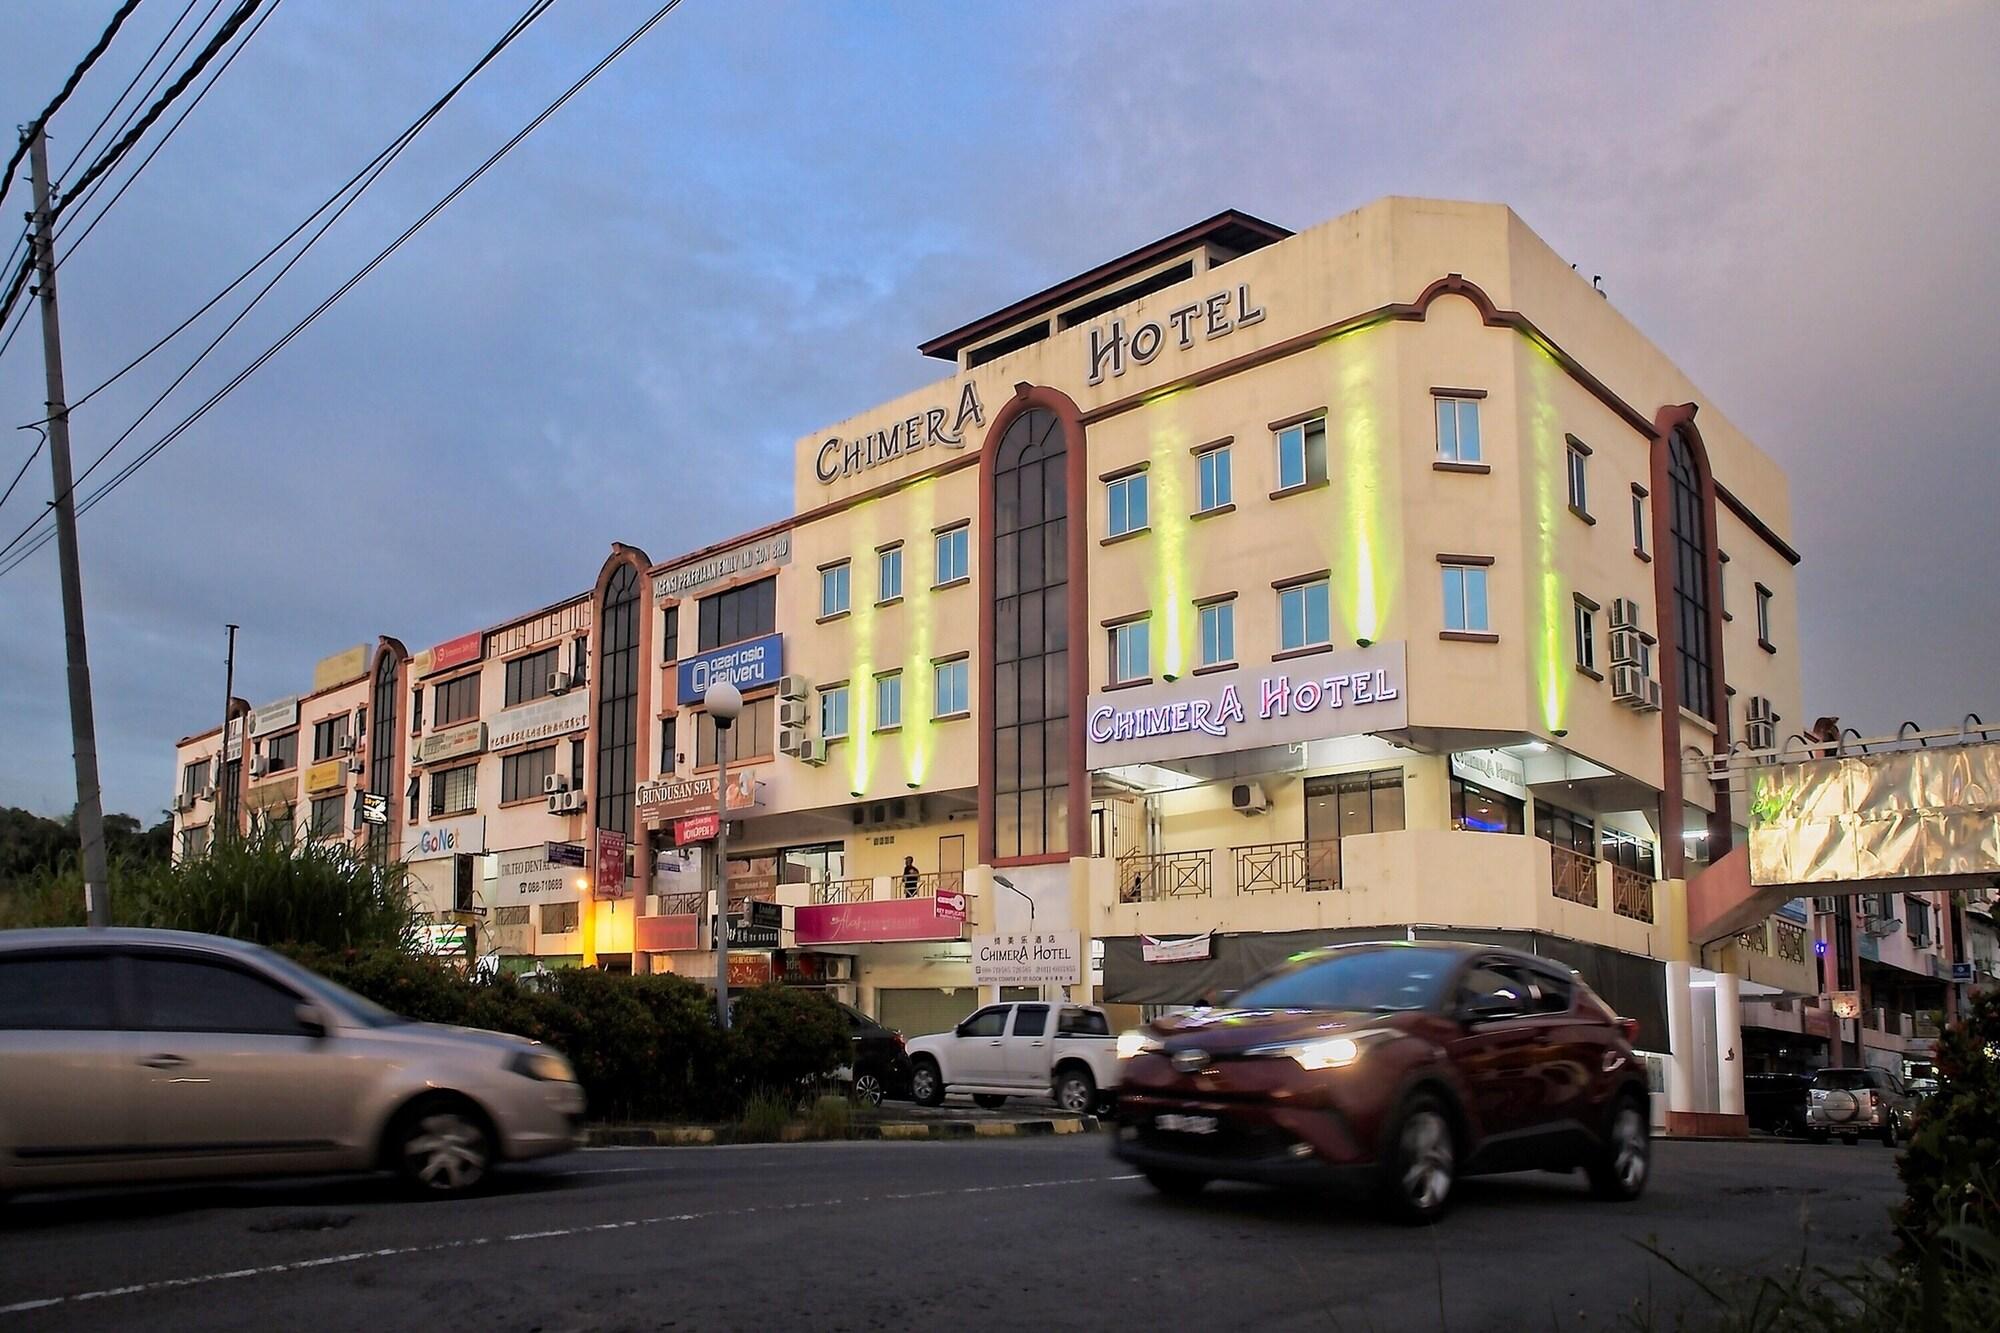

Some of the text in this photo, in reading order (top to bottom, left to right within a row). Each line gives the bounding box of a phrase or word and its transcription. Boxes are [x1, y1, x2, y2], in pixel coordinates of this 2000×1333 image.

[815, 283, 1266, 484] CHIMERA HOTEL
[740, 645, 765, 663] asia
[1088, 669, 1399, 744] CHIMERA HOTEL
[642, 782, 693, 805] BUNDUSAN
[694, 779, 712, 795] SPA
[420, 828, 460, 854] GoNet
[980, 945, 1072, 965] CHIMERA HOTEL
